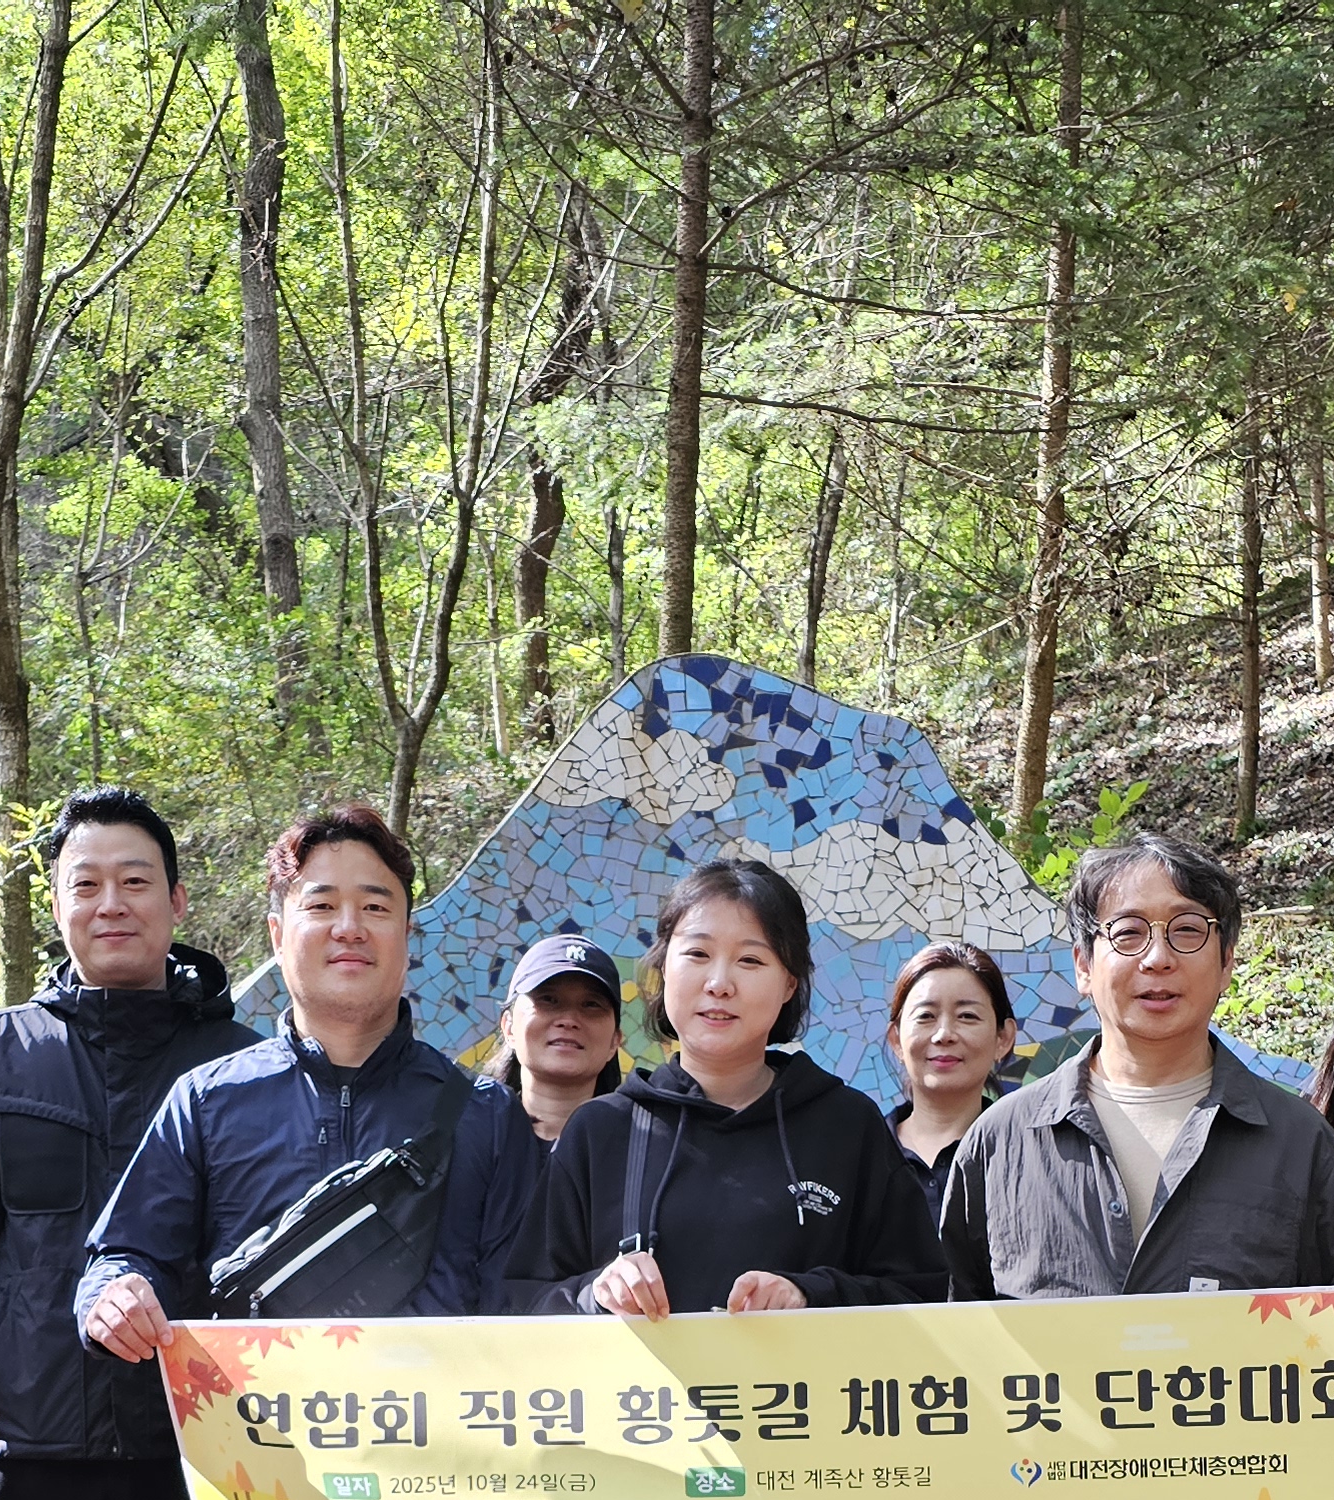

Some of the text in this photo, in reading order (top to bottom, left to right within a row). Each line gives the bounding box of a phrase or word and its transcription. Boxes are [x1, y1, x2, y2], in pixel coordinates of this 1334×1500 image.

[236, 1389, 428, 1449] 연합회
[459, 1388, 587, 1447] 직원
[616, 1381, 811, 1443] 황톳길
[839, 1374, 969, 1437] 체험
[1002, 1371, 1062, 1433] 및
[756, 1465, 933, 1491] 대전 계족산 황톳길
[1069, 1453, 1289, 1480] 대전장애인단체총연합회
[332, 1475, 372, 1497] 일자
[389, 1472, 597, 1496] 2025년 10월 24일(금)
[695, 1471, 736, 1494] 장소
